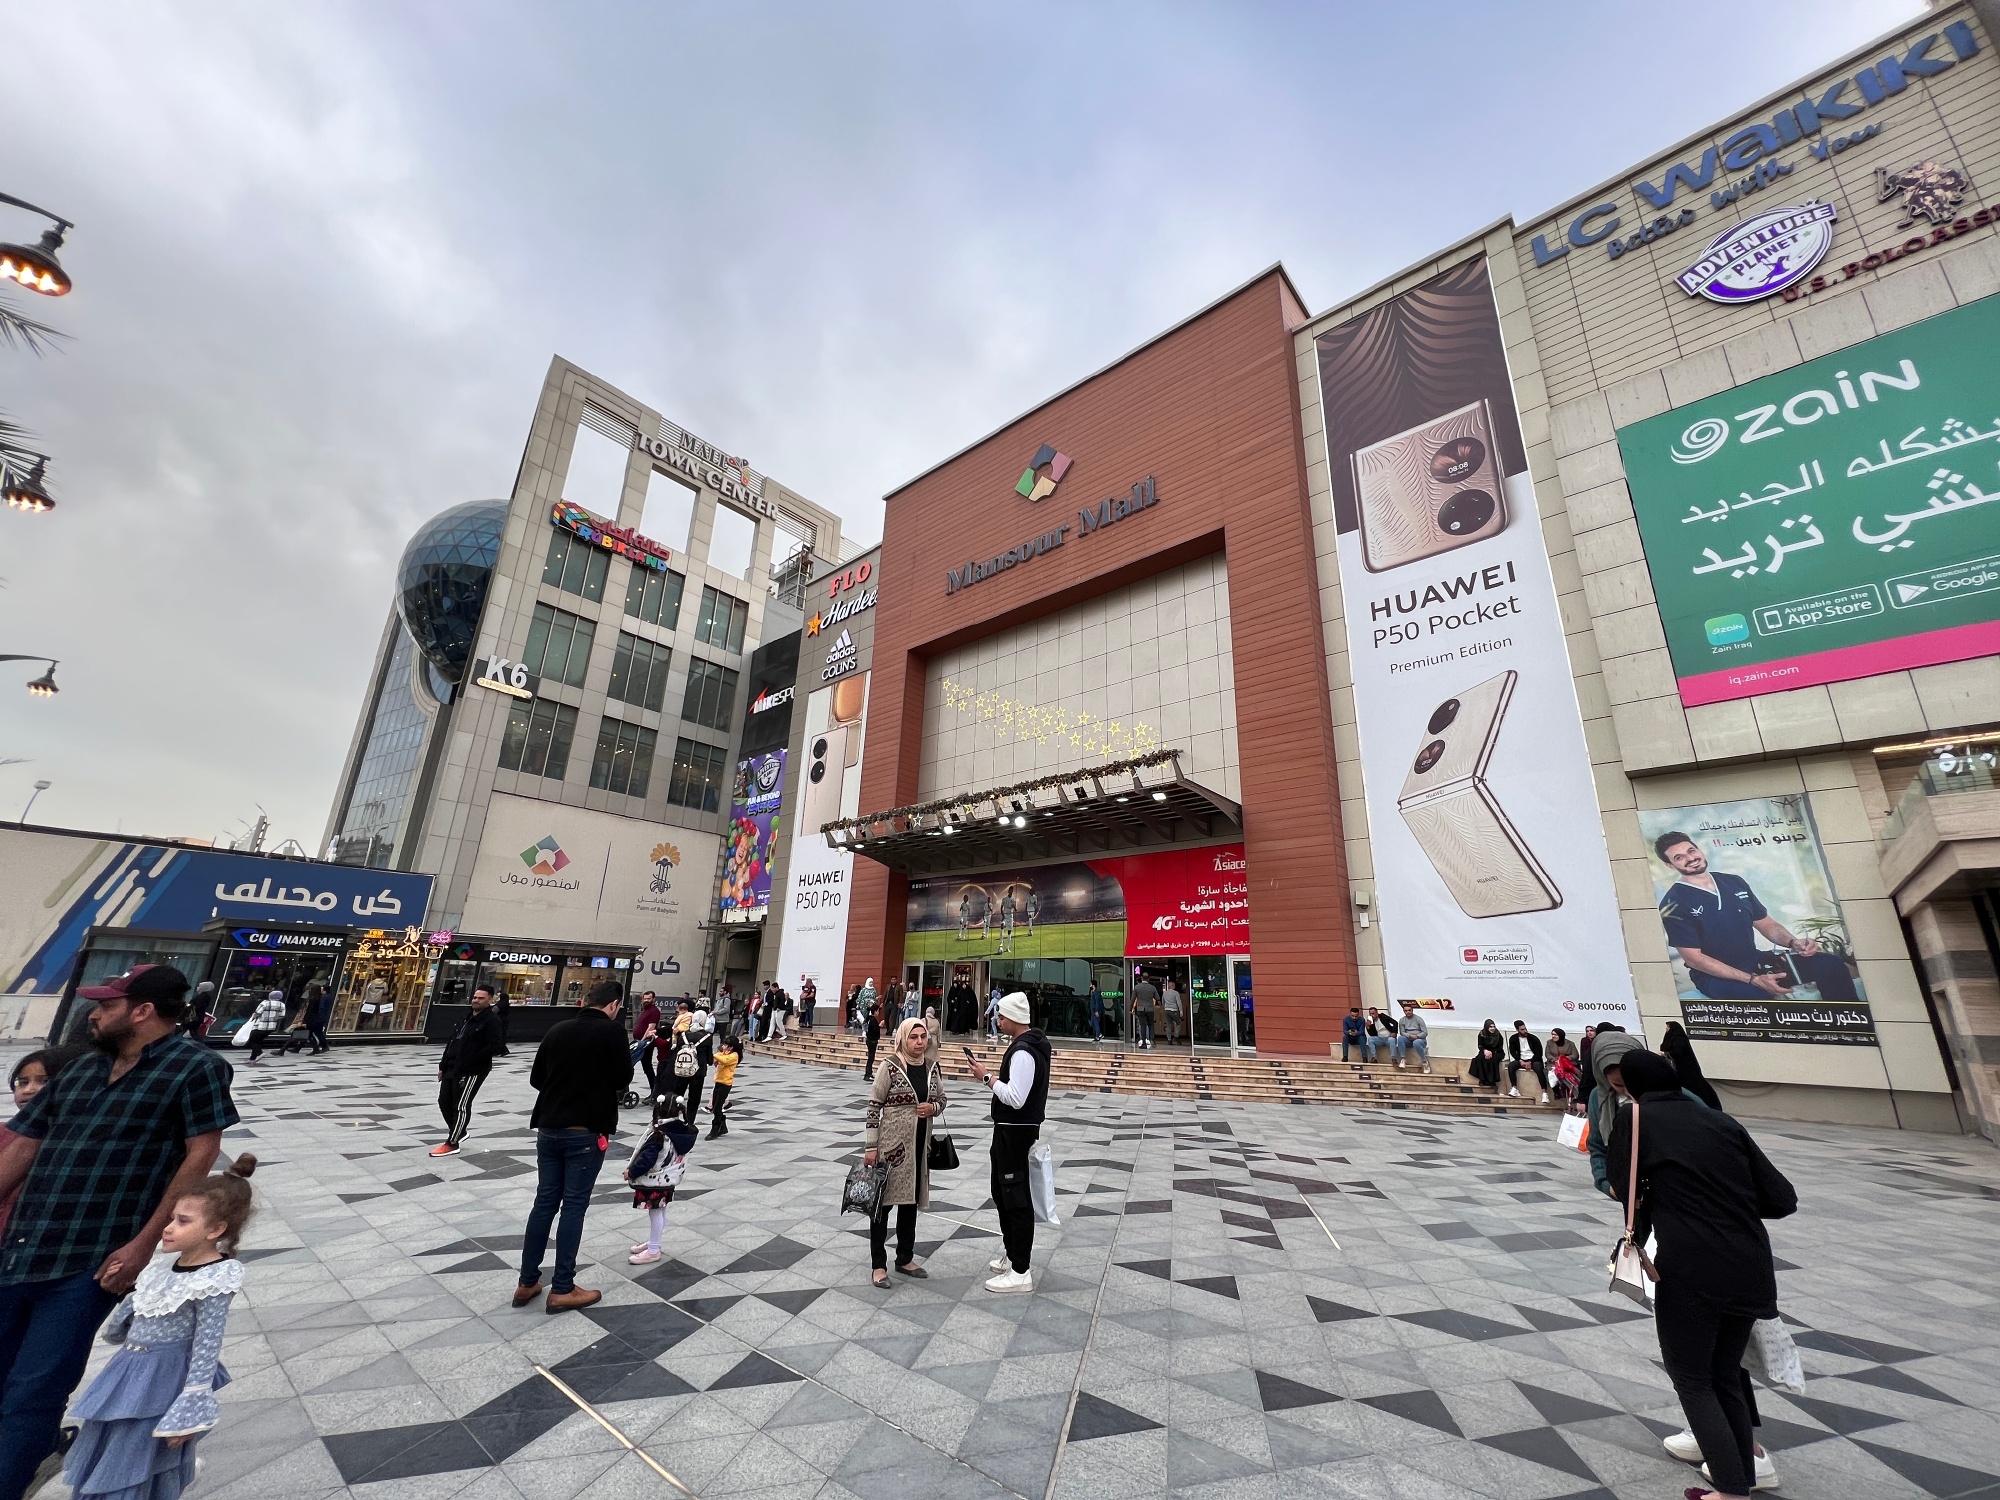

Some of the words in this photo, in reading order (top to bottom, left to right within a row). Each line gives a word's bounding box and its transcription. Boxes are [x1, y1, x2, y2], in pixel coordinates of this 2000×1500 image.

[1606, 208, 1697, 261] Better
[1808, 120, 1884, 162] You
[1530, 202, 1621, 269] LC
[1685, 205, 1833, 291] ADVENTURE
[1732, 233, 1800, 277] PLANET
[1781, 274, 1839, 304] U.S.
[1842, 236, 1927, 279] POLO
[1734, 359, 1921, 444] zain
[637, 431, 699, 478] TOWN
[705, 470, 779, 521] CENTER
[1681, 459, 1825, 524] الجديد
[1852, 460, 2000, 553] شي
[945, 524, 1070, 596] Mansour
[1077, 475, 1160, 538] Mall
[1692, 513, 1825, 580] تريد
[829, 562, 872, 598] FLO
[1930, 567, 1968, 581] ANDROID
[1969, 563, 1988, 574] APP
[1932, 571, 1999, 593] Google
[1369, 560, 1517, 622] HUAWEI
[820, 585, 879, 630] Hardee
[1784, 598, 1832, 615] Available
[1834, 594, 1848, 605] on
[1850, 590, 1869, 602] the
[1787, 609, 1823, 627] App
[1825, 597, 1872, 618] Store
[1373, 621, 1420, 649] P50
[1428, 594, 1522, 635] Pocket
[826, 645, 856, 664] adidas
[1389, 650, 1454, 674] Premium
[1459, 636, 1513, 658] Edition
[1711, 643, 1732, 655] Zain
[1733, 641, 1753, 653] Iraq
[484, 654, 529, 689] K6
[821, 657, 857, 681] COLIN'S
[1728, 664, 1800, 686] iq.zain.com
[1425, 789, 1445, 800] HUAWEI
[499, 872, 529, 885] مول
[530, 876, 581, 891] المنصور
[798, 870, 844, 887] HUAWEI
[1198, 885, 1220, 897] سارة!
[1223, 882, 1248, 896] فاجأة
[796, 891, 818, 909] P50
[821, 890, 841, 907] Pro
[1180, 900, 1216, 913] الشهرية
[656, 906, 678, 915] Babylon
[1152, 915, 1173, 931] 4G
[1184, 919, 1209, 930] بسرعة
[1210, 916, 1228, 929] إلكم
[249, 933, 309, 948] CULLINAN
[309, 936, 344, 947] VAPE
[489, 951, 552, 965] POBPINO
[1482, 953, 1528, 962] AppGallery
[1577, 1002, 1627, 1012] 80070060
[1775, 1008, 1811, 1026] حسين
[1811, 1008, 1834, 1027] ليث
[1836, 1010, 1869, 1026] دكتور
